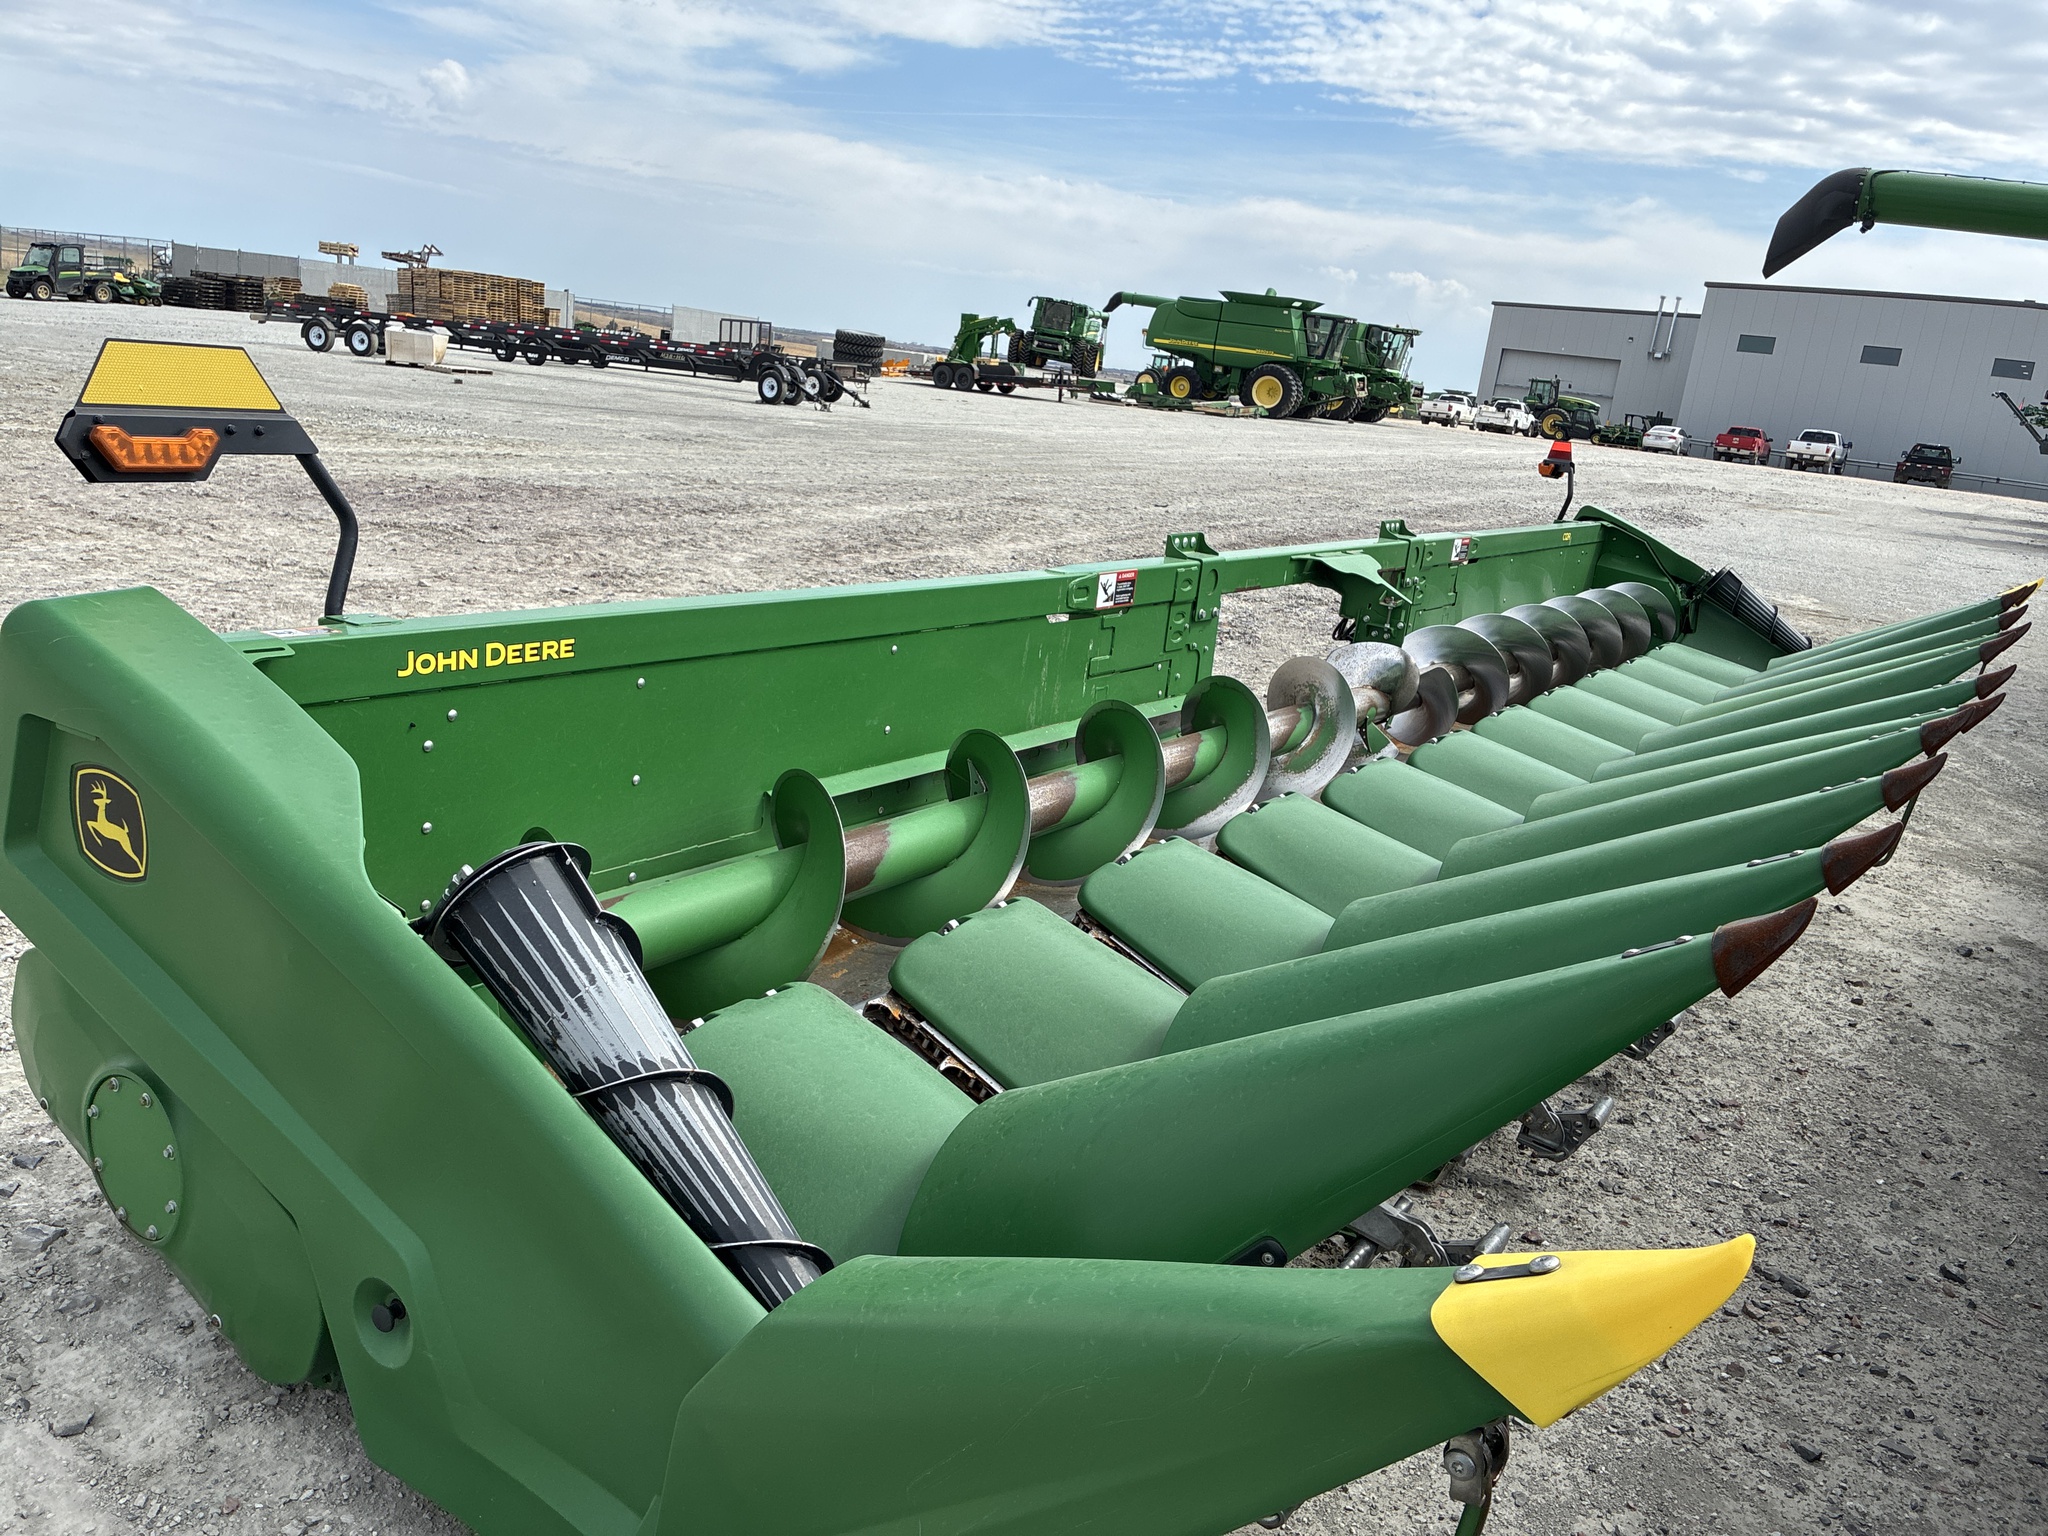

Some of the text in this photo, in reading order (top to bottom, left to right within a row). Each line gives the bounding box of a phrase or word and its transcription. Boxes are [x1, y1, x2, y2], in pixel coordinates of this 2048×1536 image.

[605, 354, 630, 362] DEMCO
[397, 638, 576, 678] JOHN DEERE
